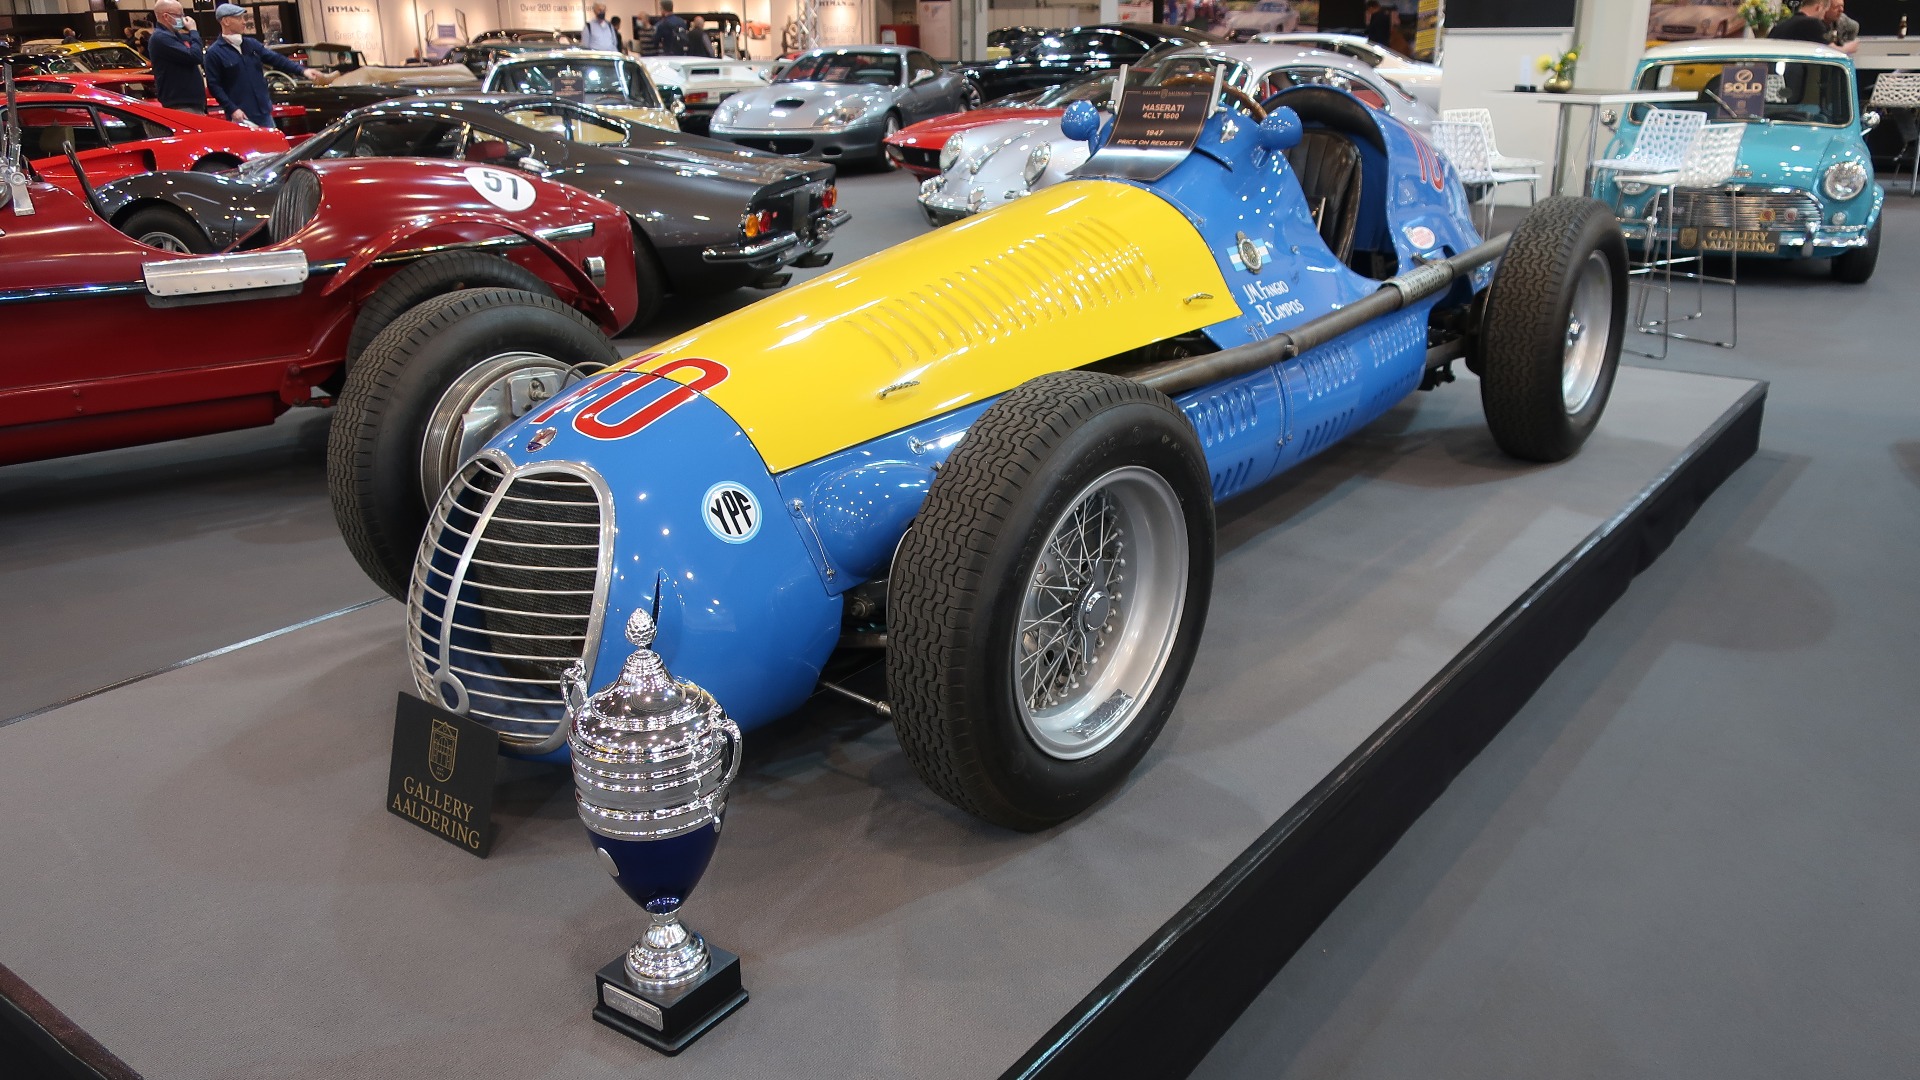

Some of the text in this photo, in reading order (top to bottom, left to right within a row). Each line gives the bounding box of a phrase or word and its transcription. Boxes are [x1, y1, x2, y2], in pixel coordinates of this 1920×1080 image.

[537, 3, 552, 12] 200
[1724, 82, 1763, 94] SOLD
[1142, 104, 1185, 112] MASERATI
[1163, 112, 1180, 120] 1600
[1706, 229, 1769, 241] GALLERY
[1700, 239, 1776, 254] AALDERING
[710, 489, 752, 535] YPF
[403, 776, 475, 823] GALLERY
[391, 792, 481, 850] AALDERING
